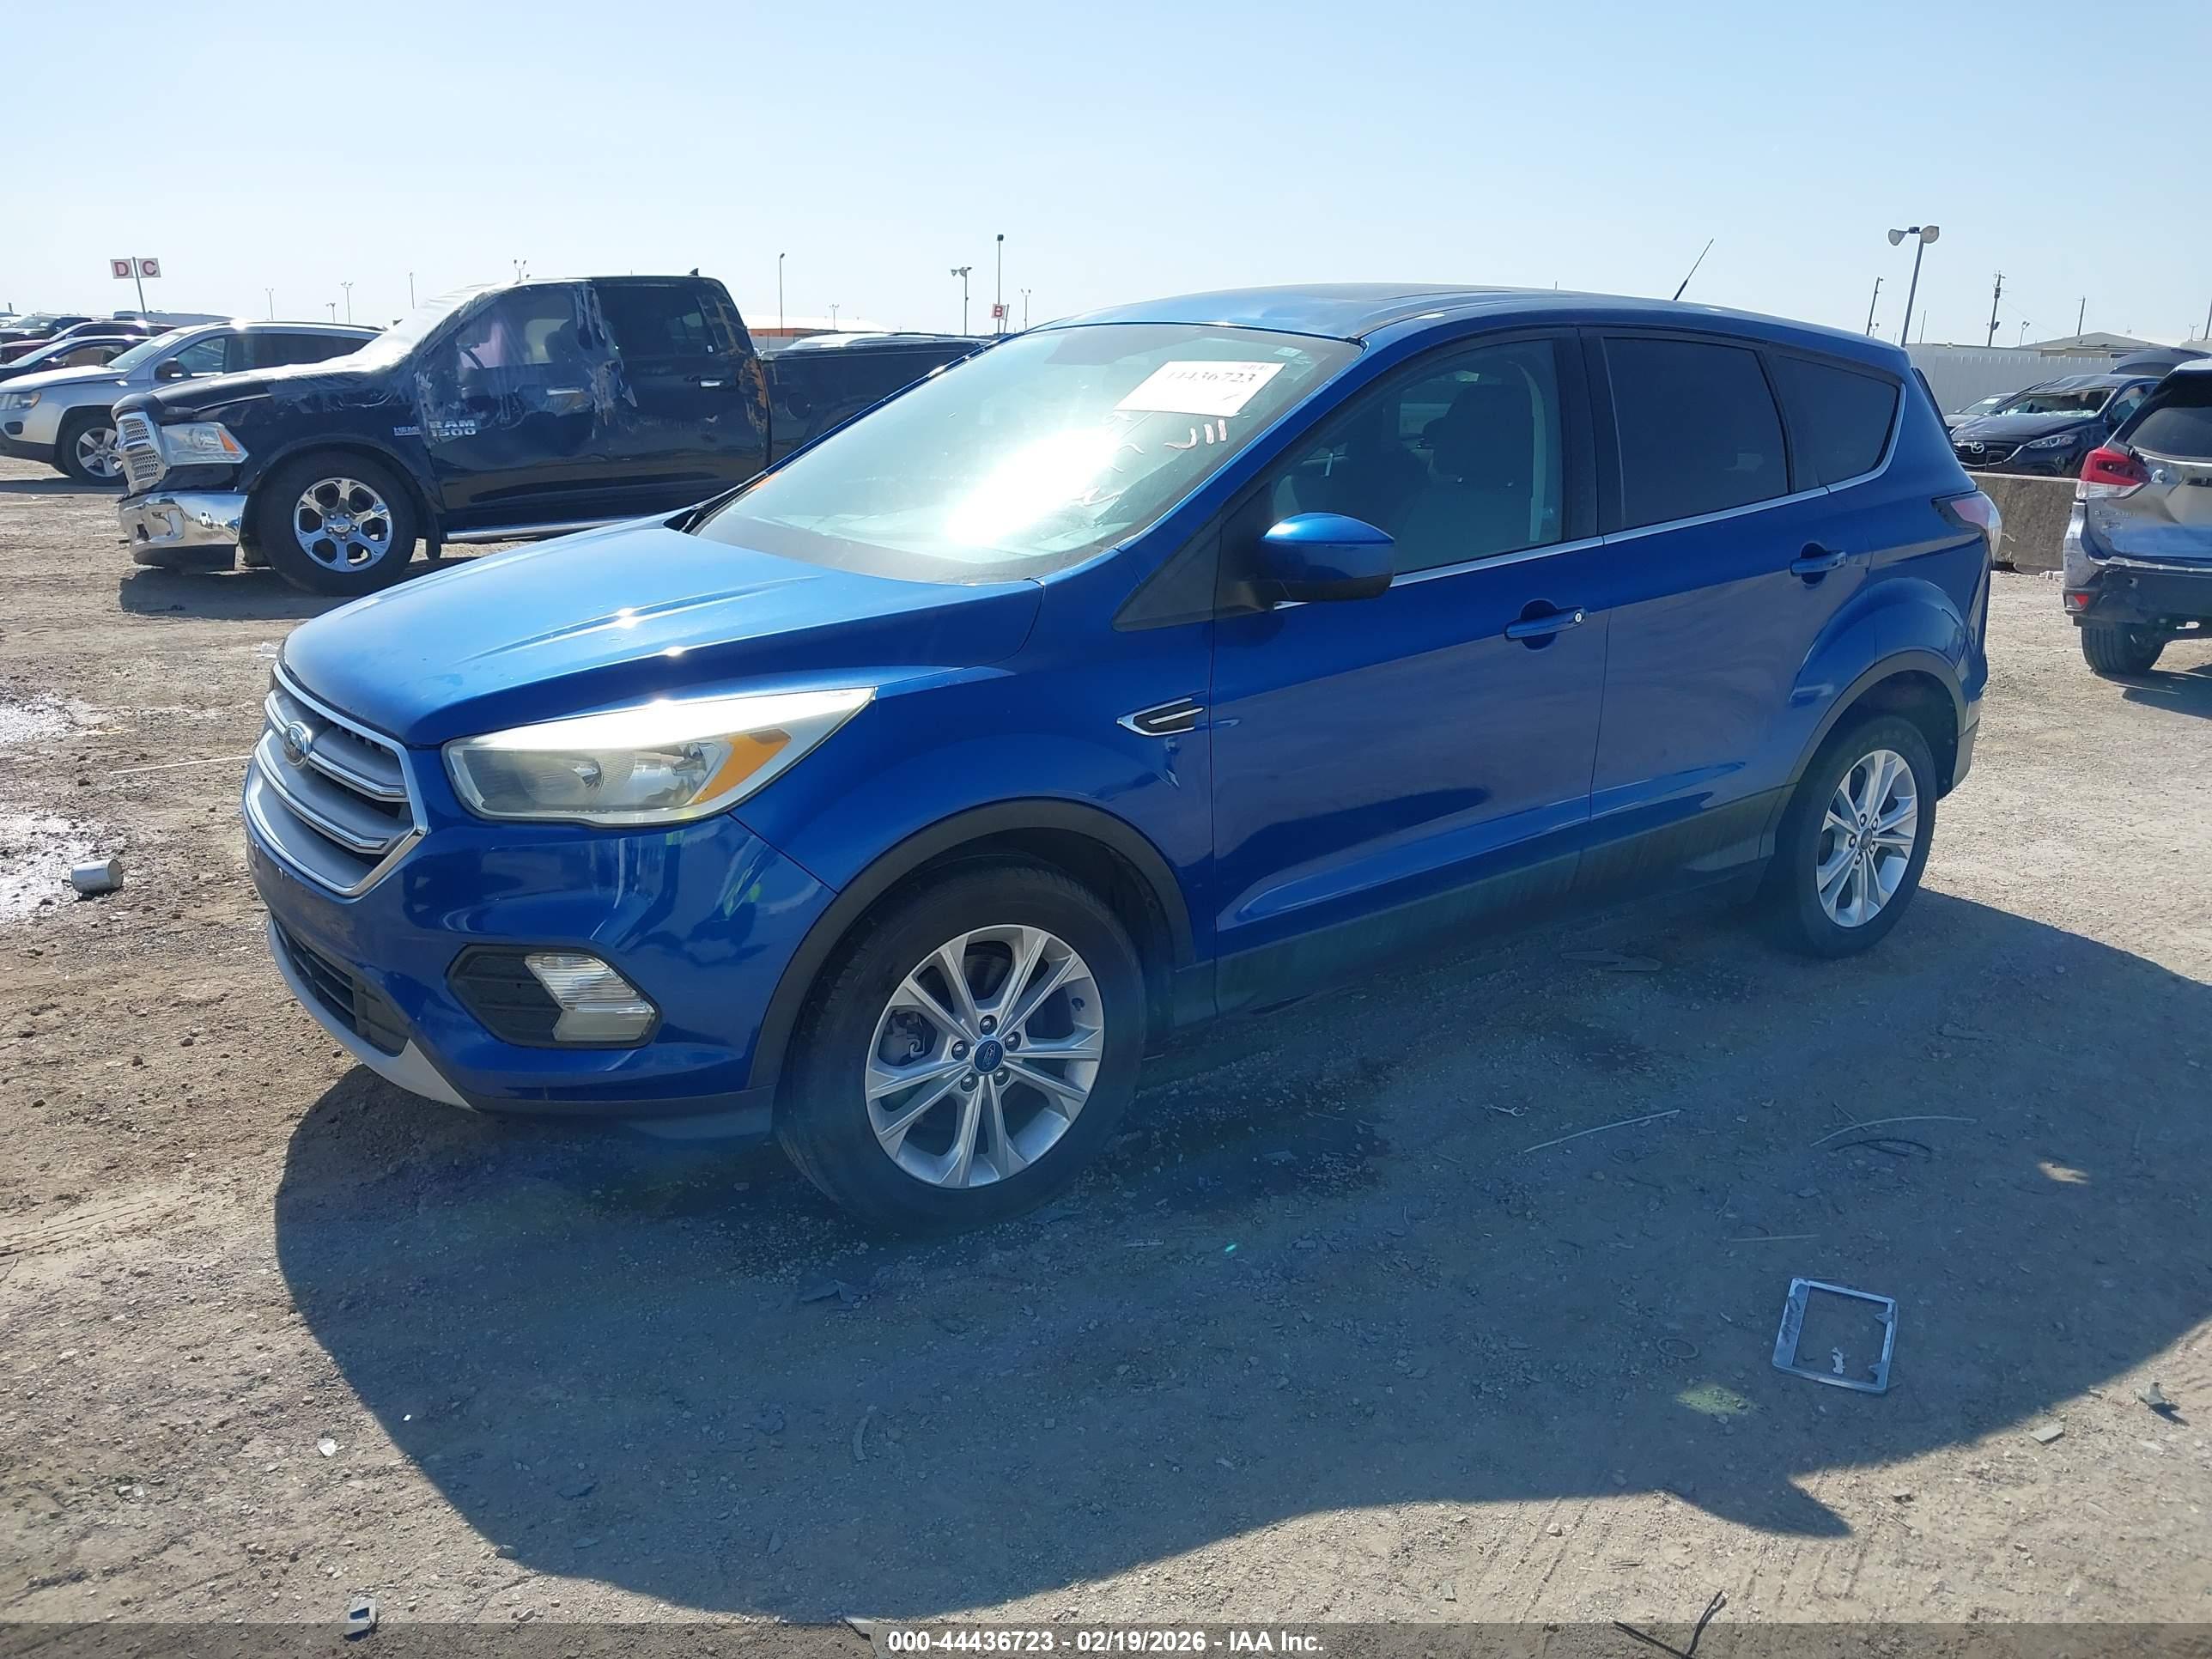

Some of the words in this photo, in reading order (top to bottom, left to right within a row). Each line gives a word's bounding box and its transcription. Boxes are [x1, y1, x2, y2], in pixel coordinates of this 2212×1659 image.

[113, 261, 130, 277] D
[142, 260, 157, 276] C
[994, 305, 1004, 318] B
[428, 419, 476, 428] RAM
[431, 428, 477, 437] 1500
